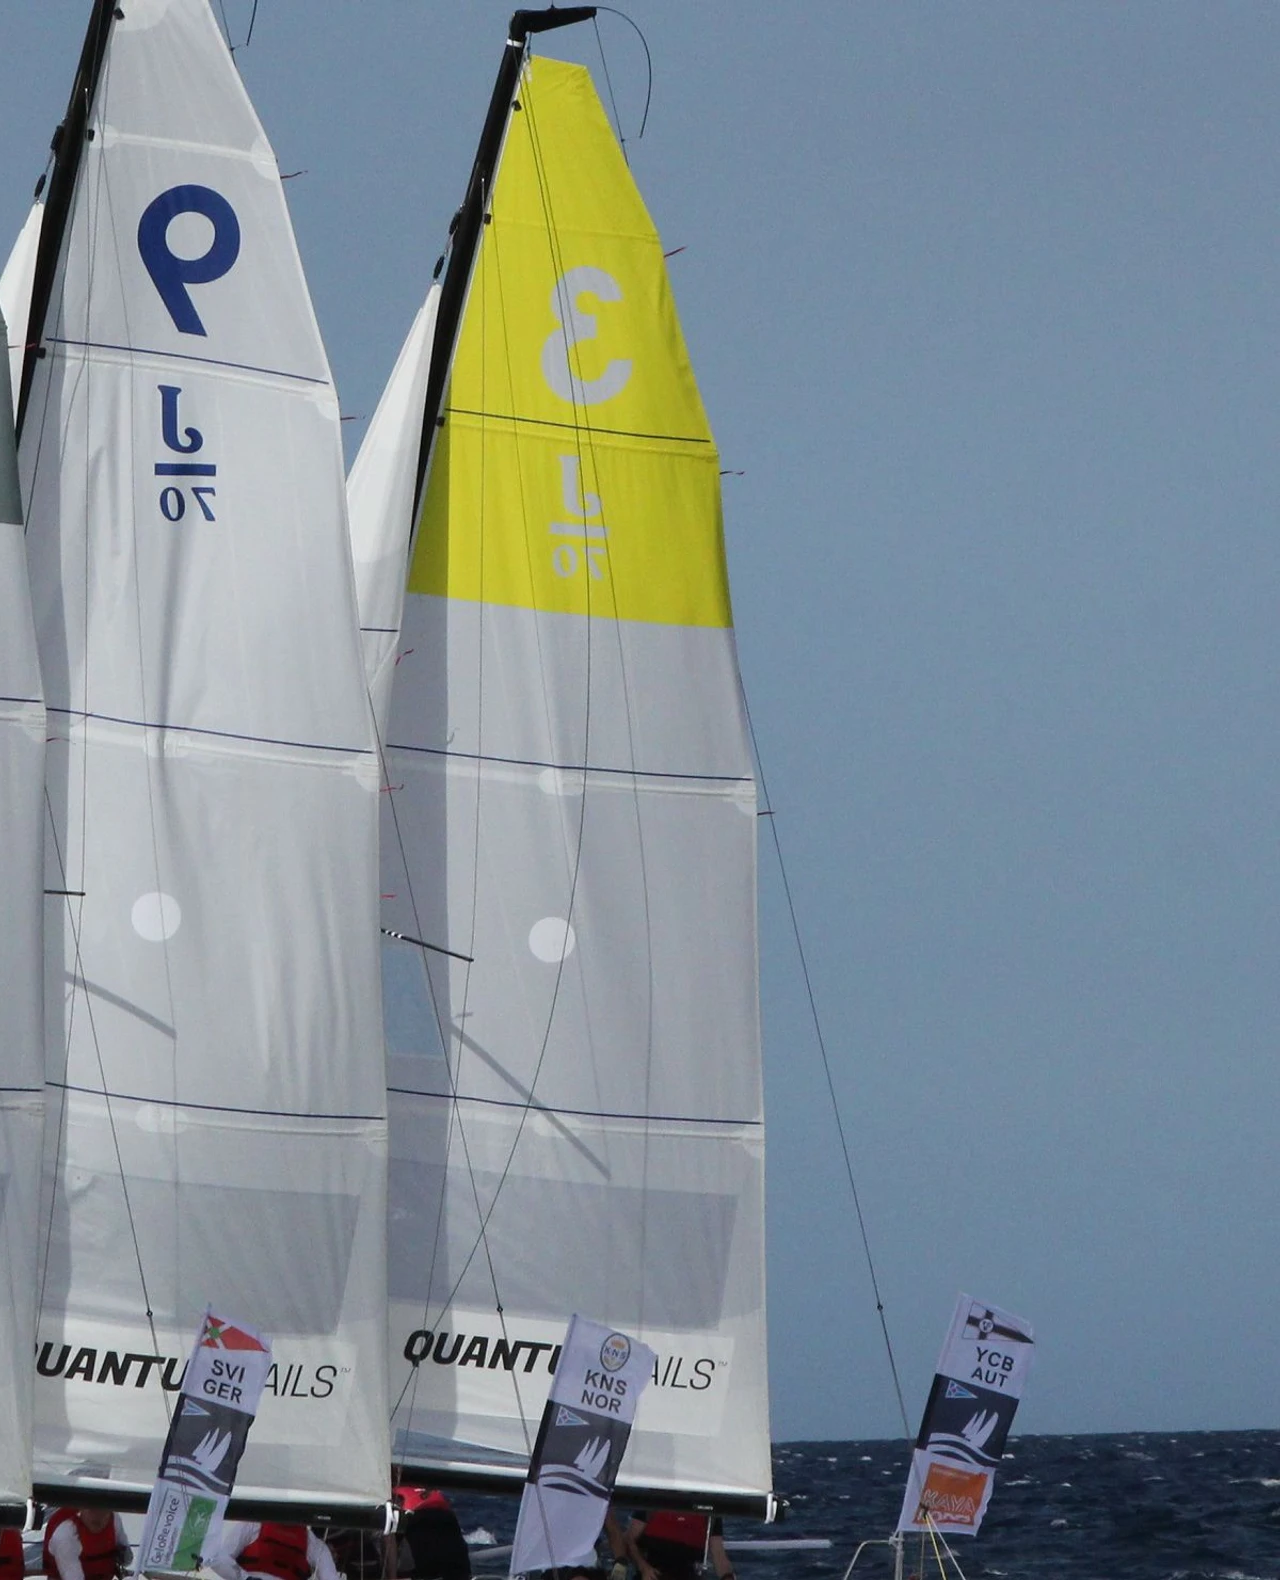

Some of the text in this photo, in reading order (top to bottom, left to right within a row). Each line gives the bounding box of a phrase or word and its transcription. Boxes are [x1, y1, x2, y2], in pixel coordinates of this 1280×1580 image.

[35, 1341, 338, 1399] UANTUAILS
[211, 1359, 246, 1383] SVI
[403, 1329, 716, 1391] QUANTILS
[976, 1346, 1015, 1372] YCB
[584, 1369, 628, 1396] KNS
[971, 1366, 1008, 1388] AUT
[203, 1378, 243, 1404] GER
[581, 1389, 622, 1414] NOR
